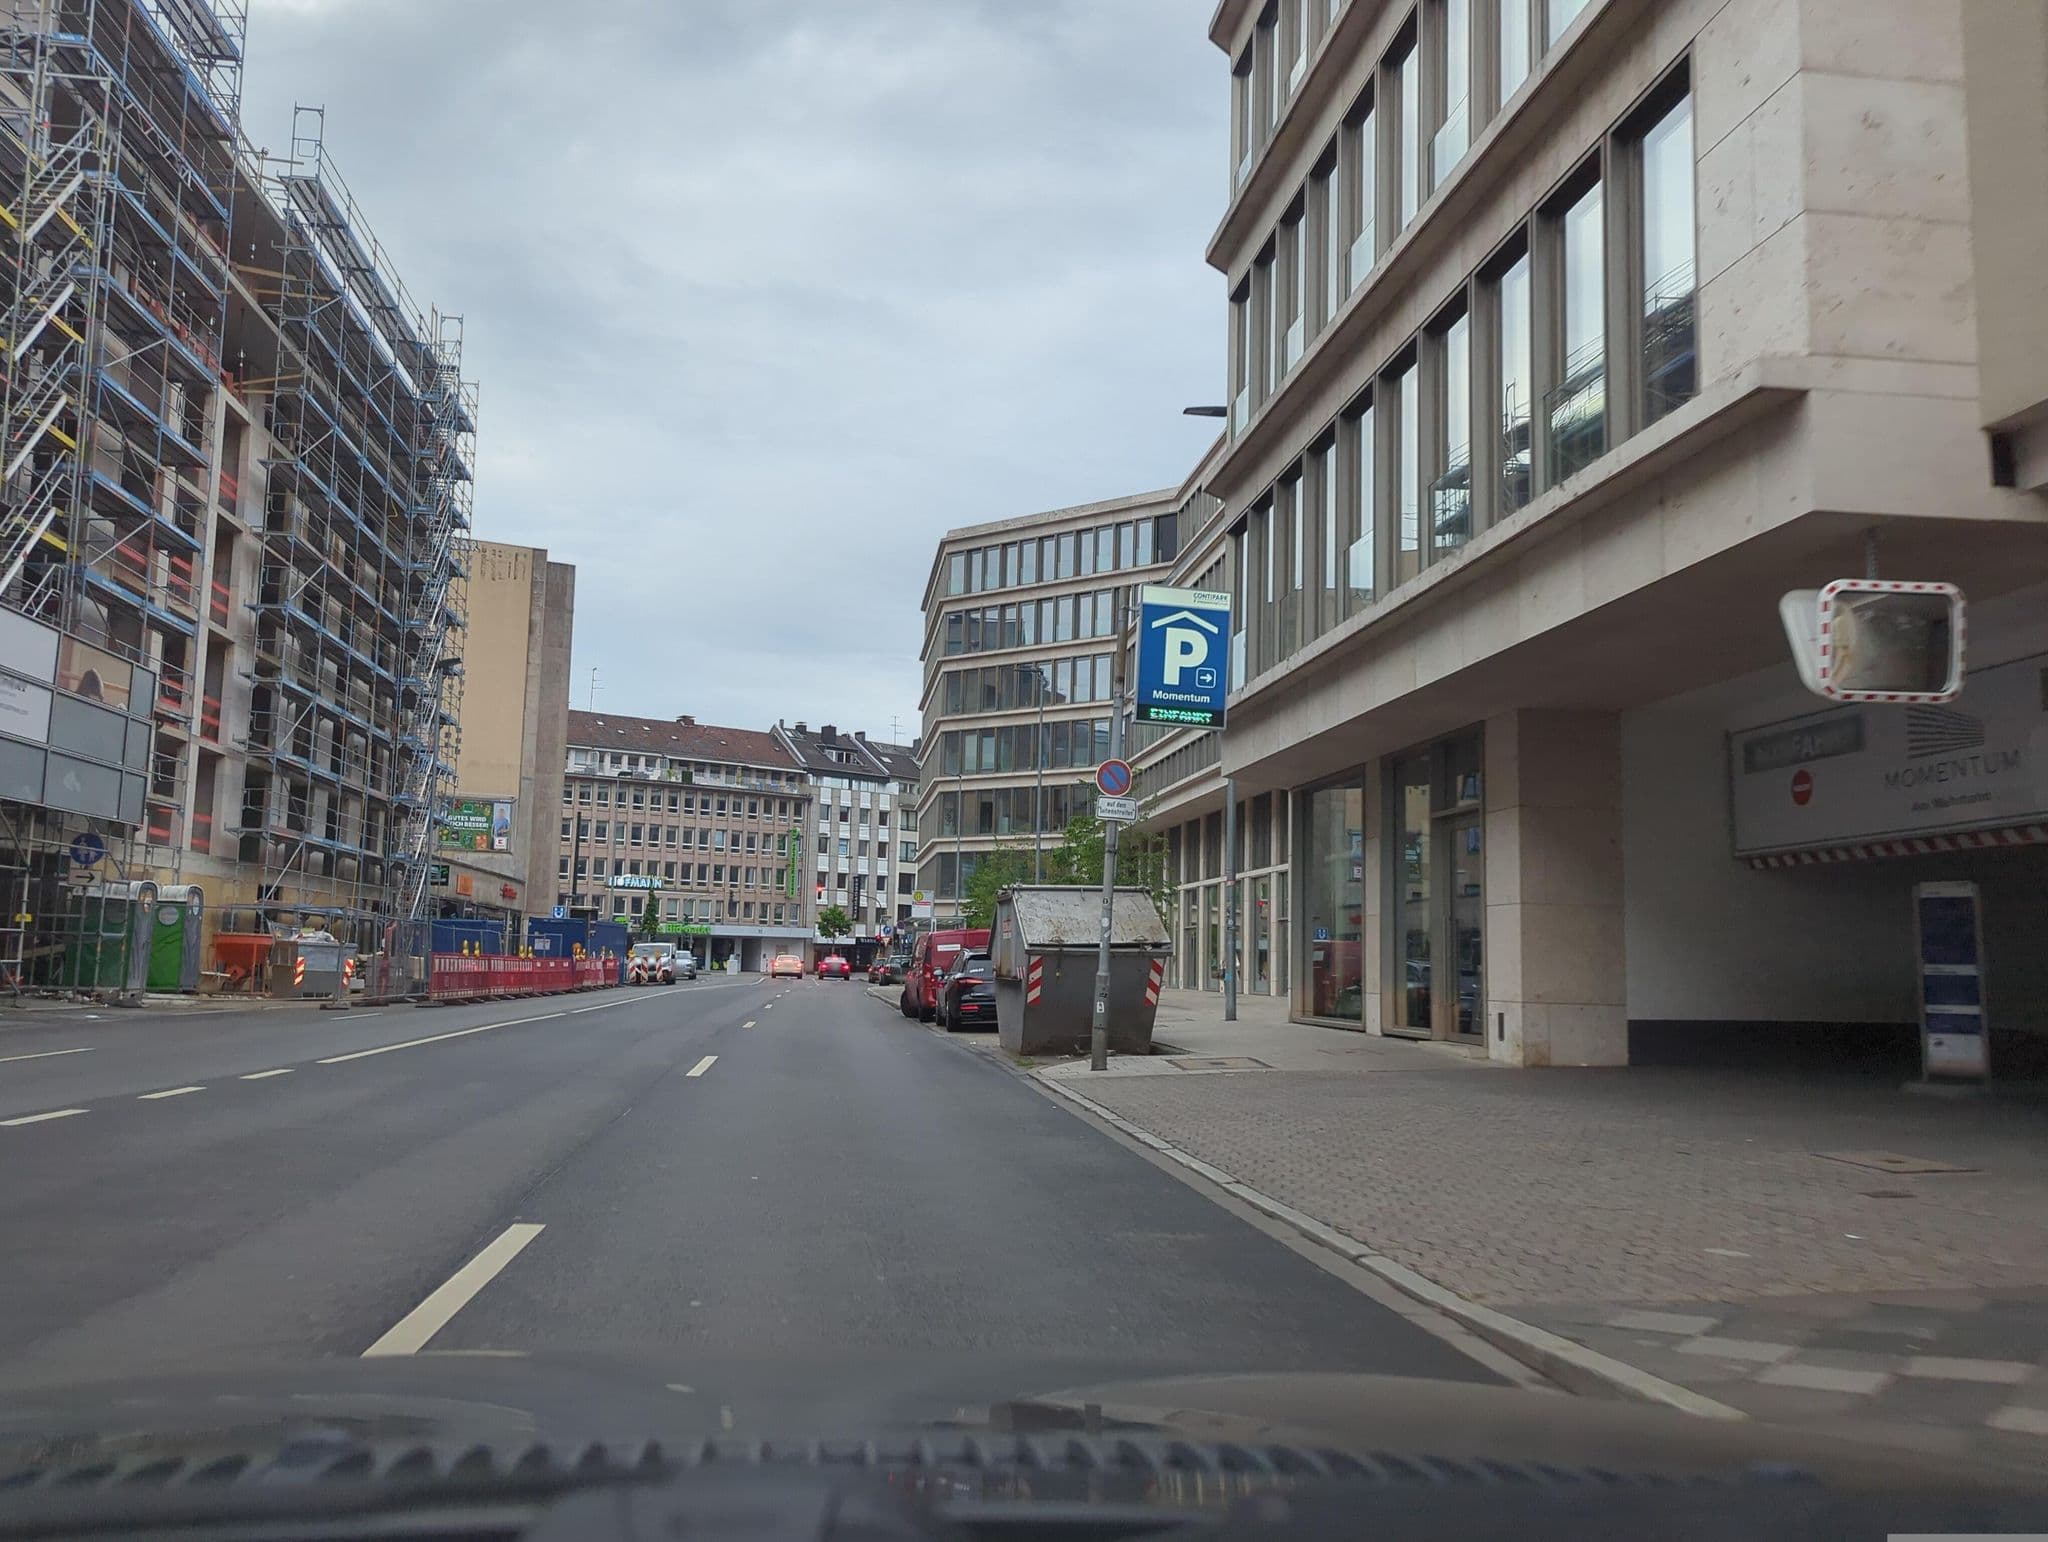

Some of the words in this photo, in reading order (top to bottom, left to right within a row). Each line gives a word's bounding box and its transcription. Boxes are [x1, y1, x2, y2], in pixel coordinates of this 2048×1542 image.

[1163, 627, 1208, 685] P
[1153, 690, 1210, 704] Momentum
[1884, 749, 2020, 790] MOMENTUM
